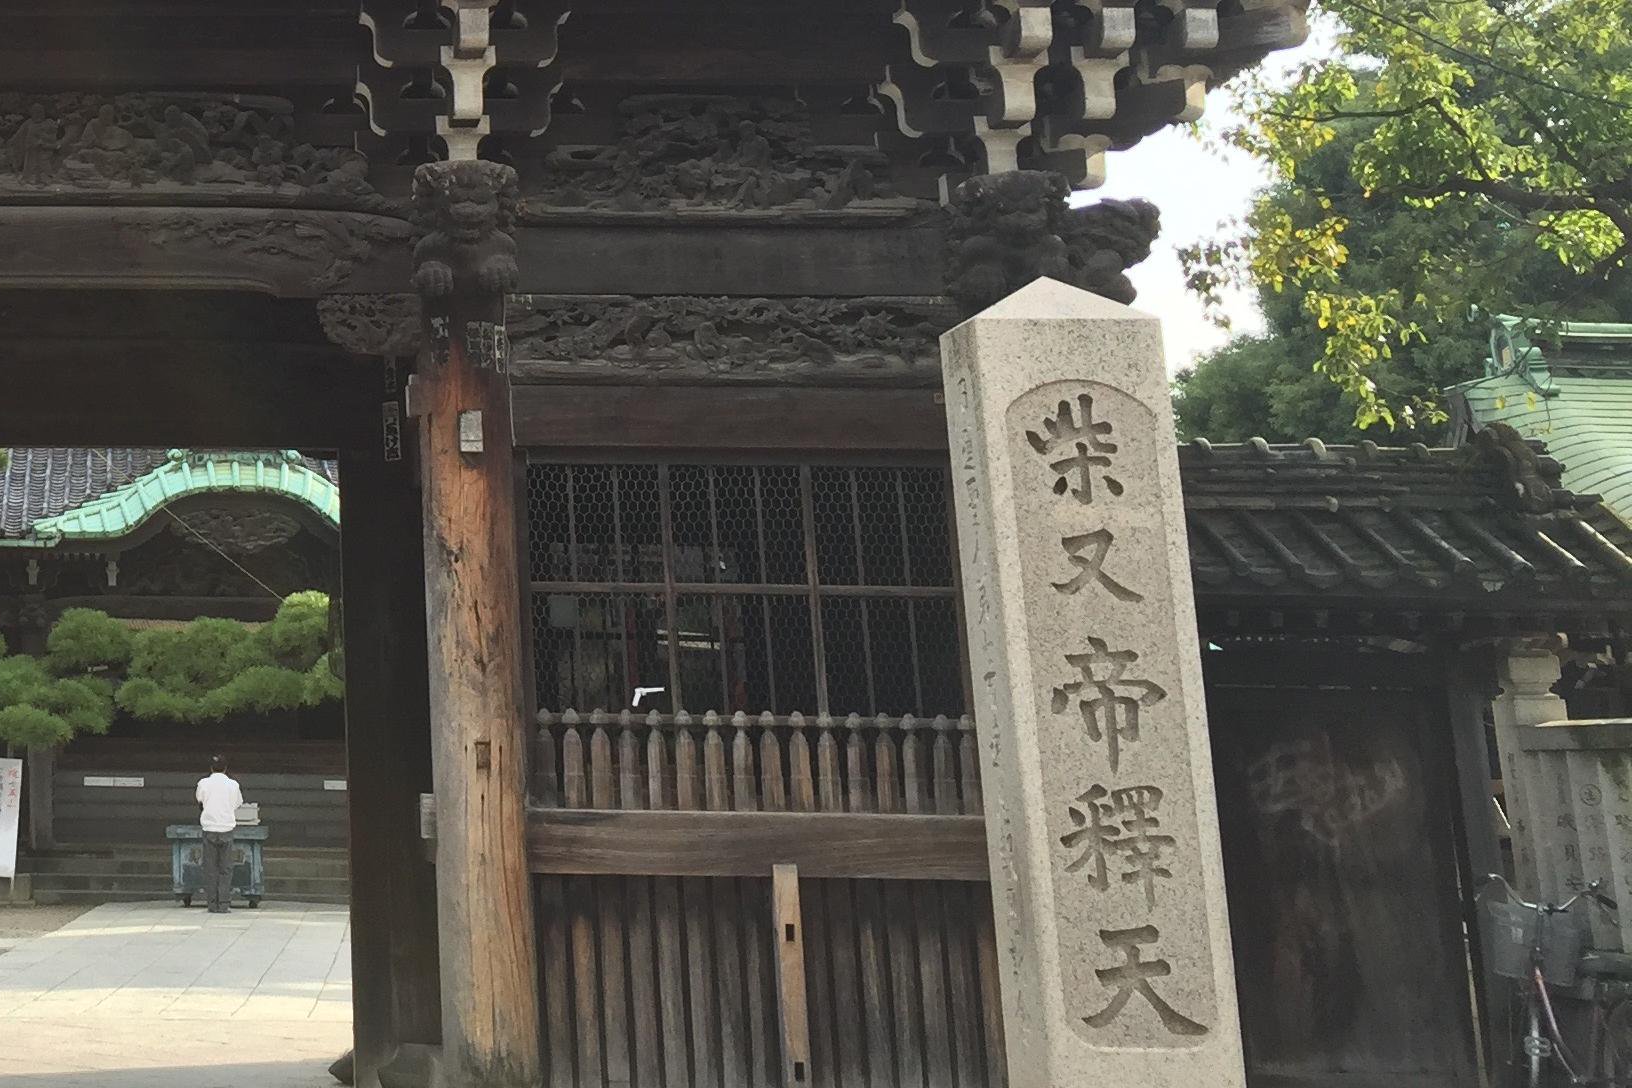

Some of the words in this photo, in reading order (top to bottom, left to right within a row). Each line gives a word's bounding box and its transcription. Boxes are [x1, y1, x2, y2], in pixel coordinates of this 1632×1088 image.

[1025, 392, 1209, 1036] 柴又帝釋天
